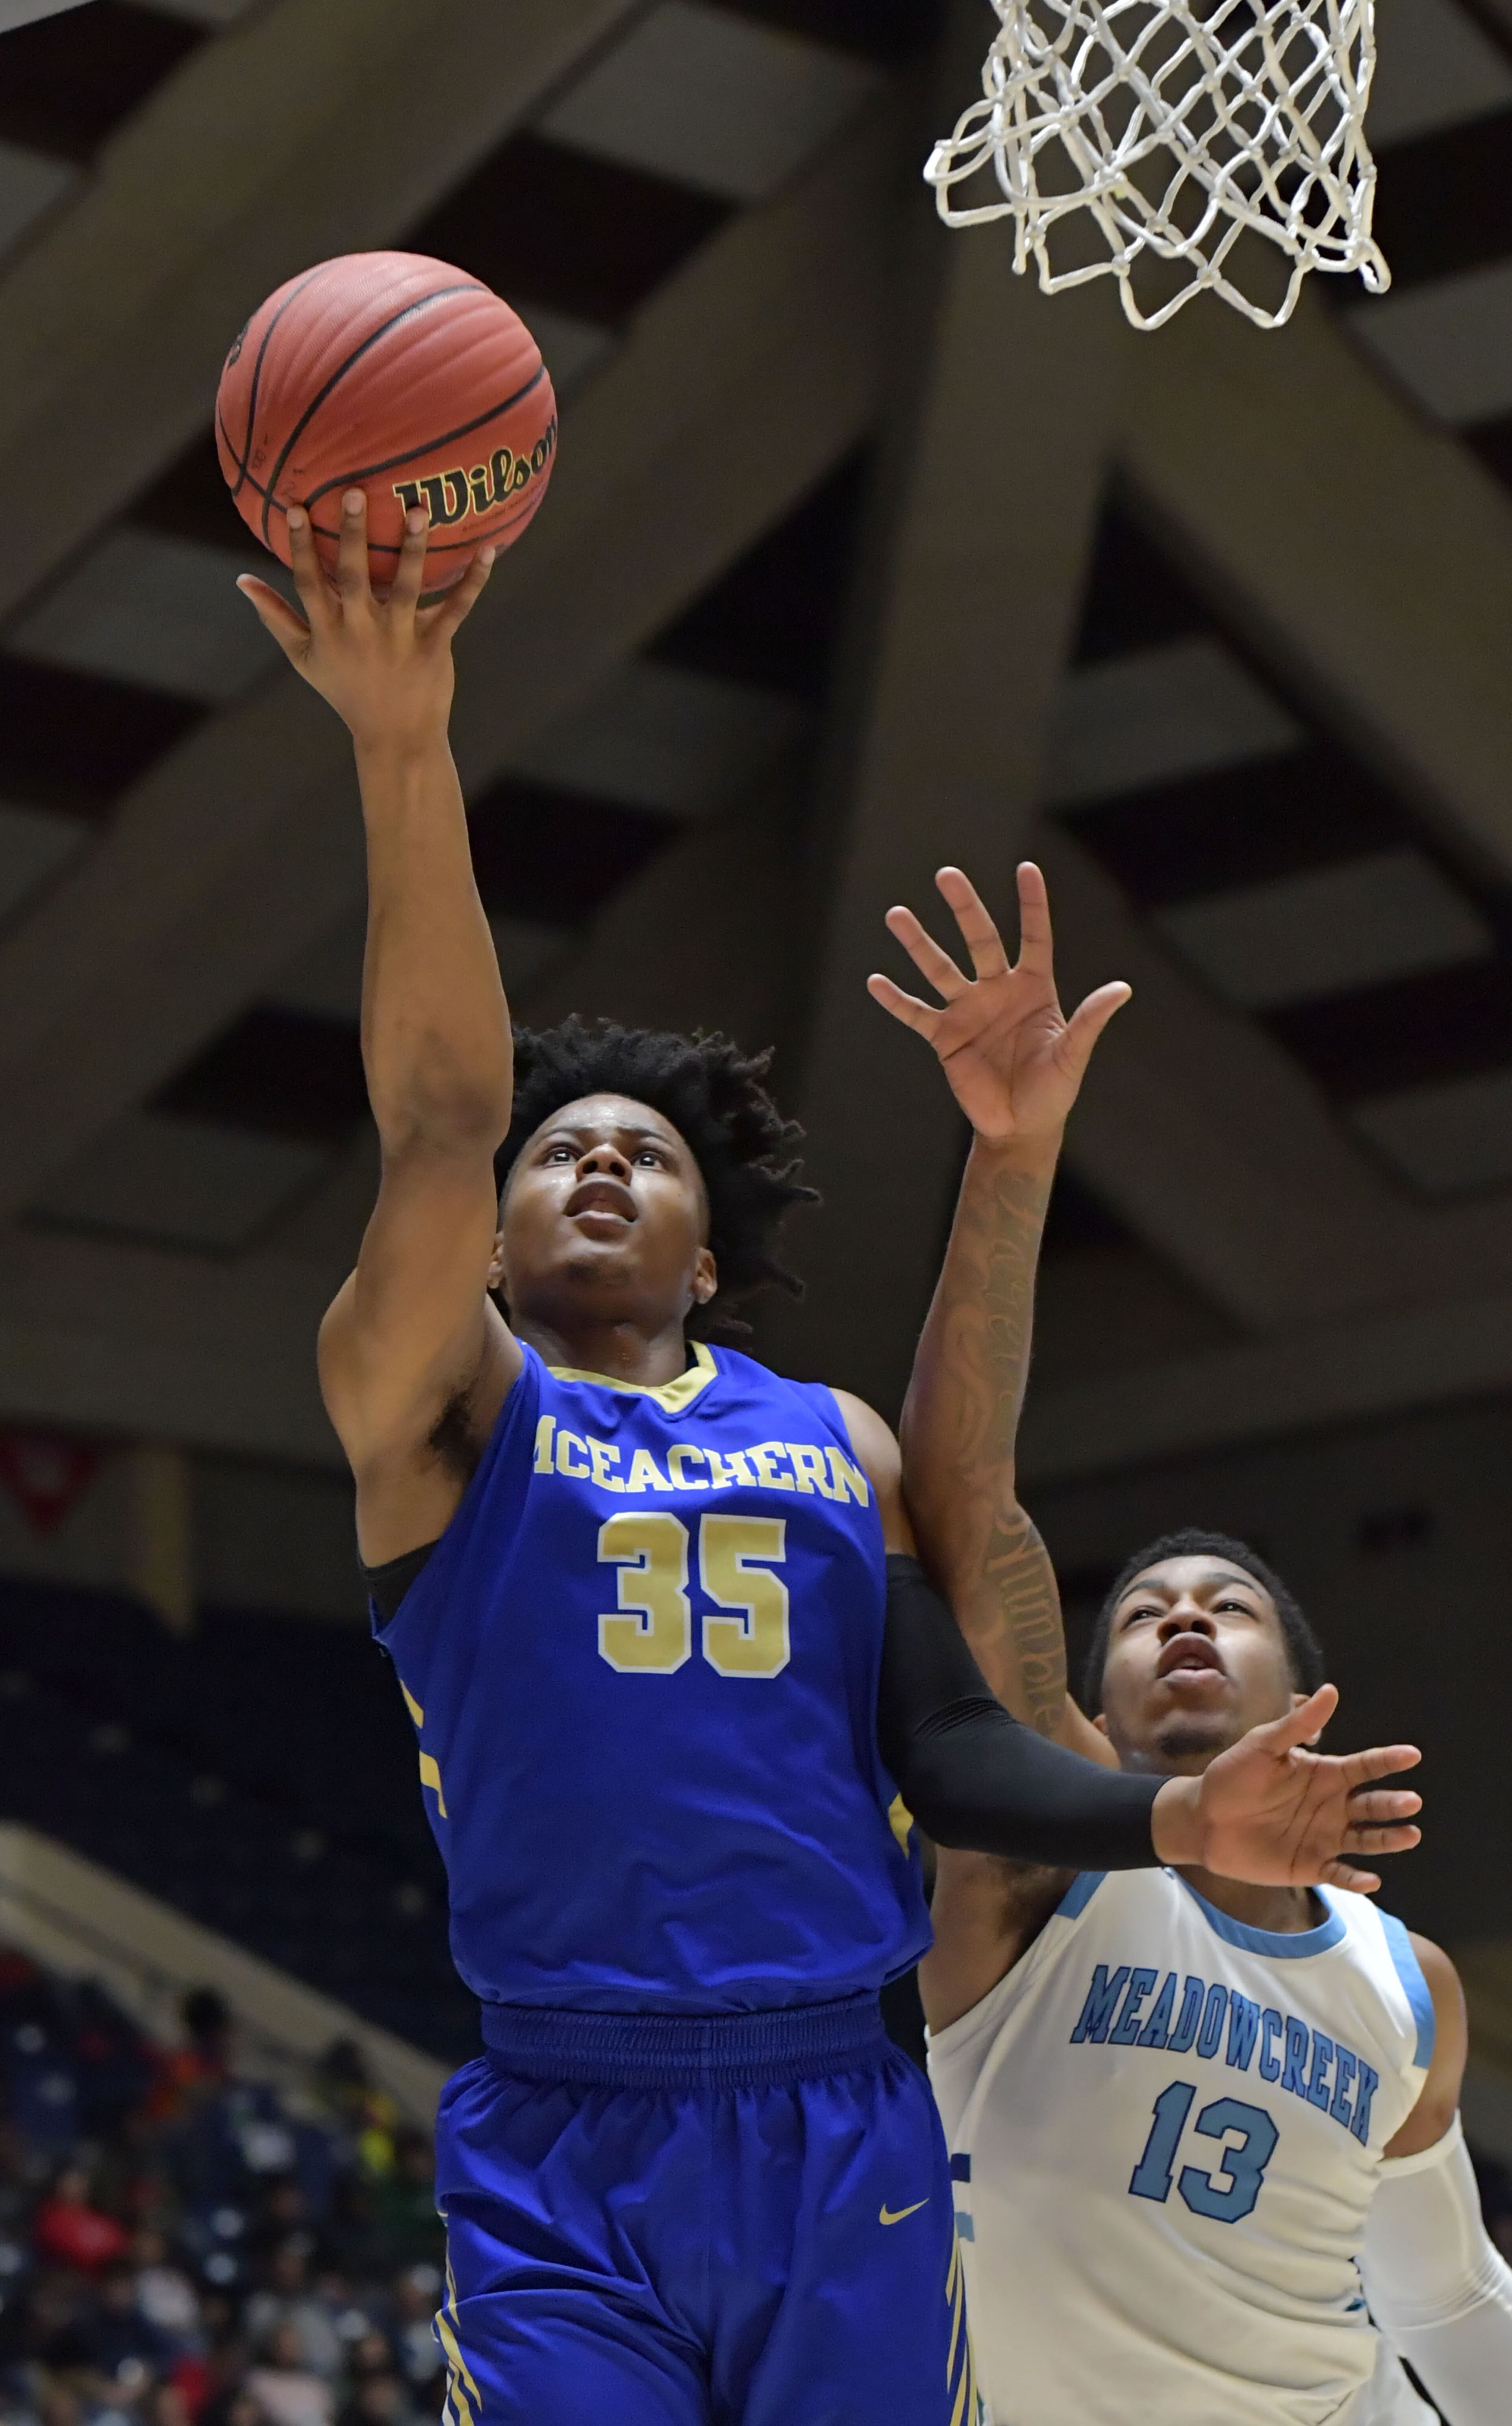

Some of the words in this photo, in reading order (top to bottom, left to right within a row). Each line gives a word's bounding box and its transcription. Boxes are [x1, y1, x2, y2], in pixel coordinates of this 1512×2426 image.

[597, 1512, 790, 1679] 35
[1069, 1964, 1379, 2147] MEADOWCREEK
[1128, 2080, 1280, 2224] 13
